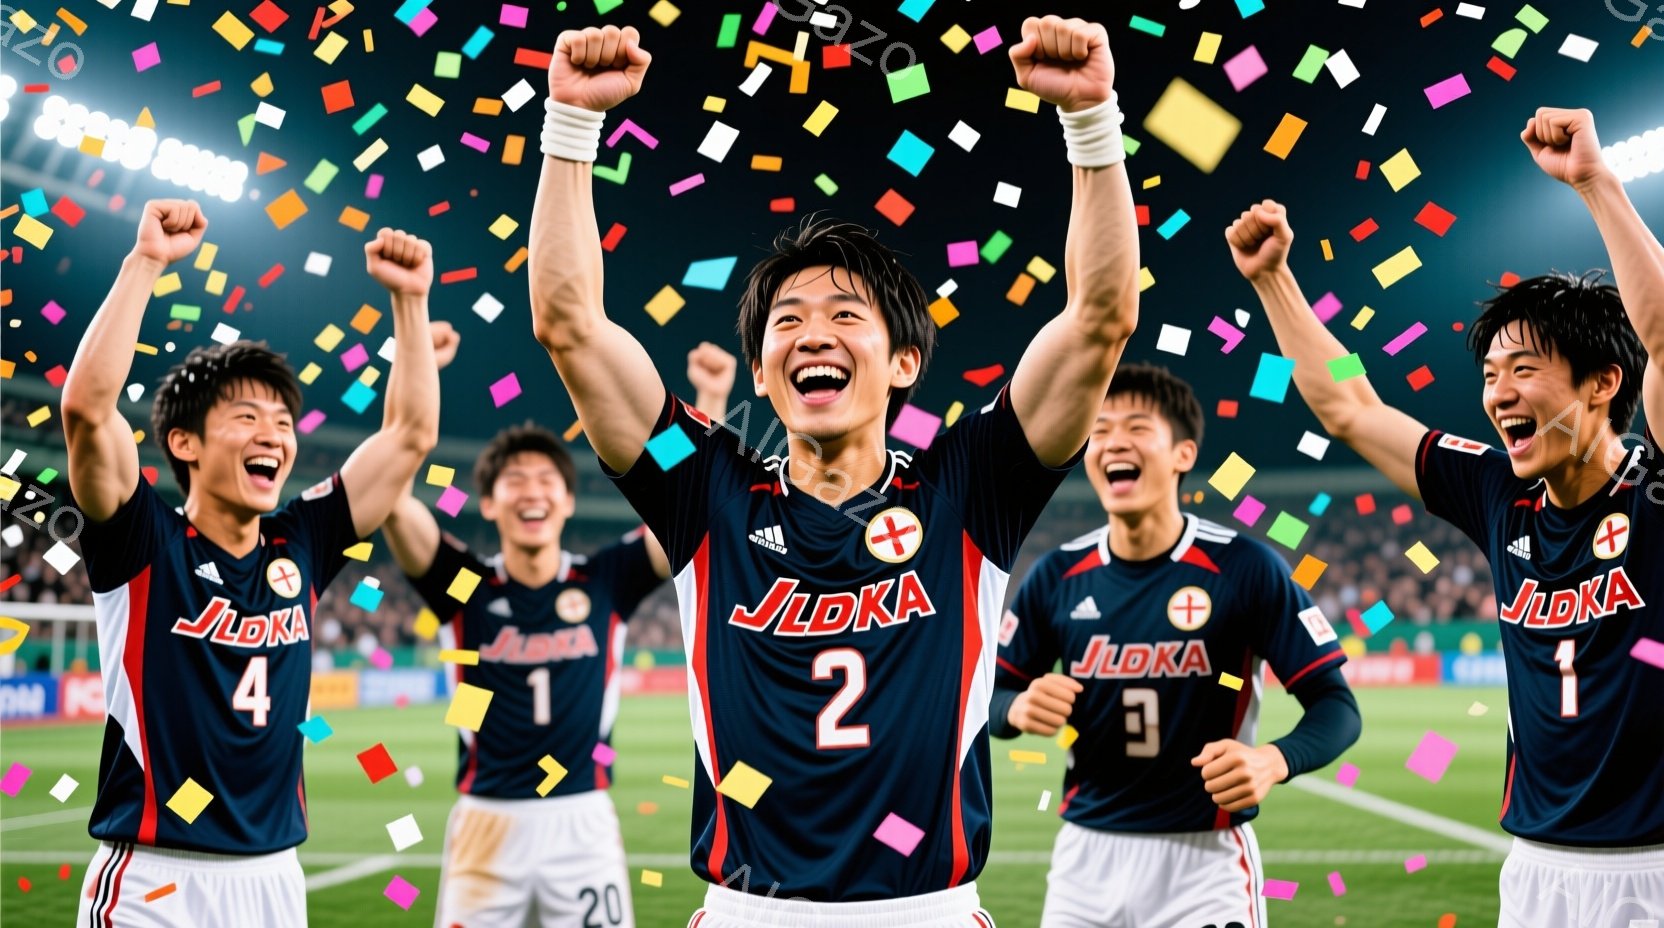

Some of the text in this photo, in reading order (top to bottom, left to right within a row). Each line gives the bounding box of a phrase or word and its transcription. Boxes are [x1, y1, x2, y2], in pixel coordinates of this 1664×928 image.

[171, 596, 309, 648] JLDKA
[728, 570, 936, 636] JLDKA
[1500, 566, 1646, 628] JLDKA
[232, 656, 271, 726] 4
[526, 667, 551, 725] 1
[811, 647, 870, 749] 2
[1554, 639, 1579, 718] 1
[578, 884, 622, 928] 20
